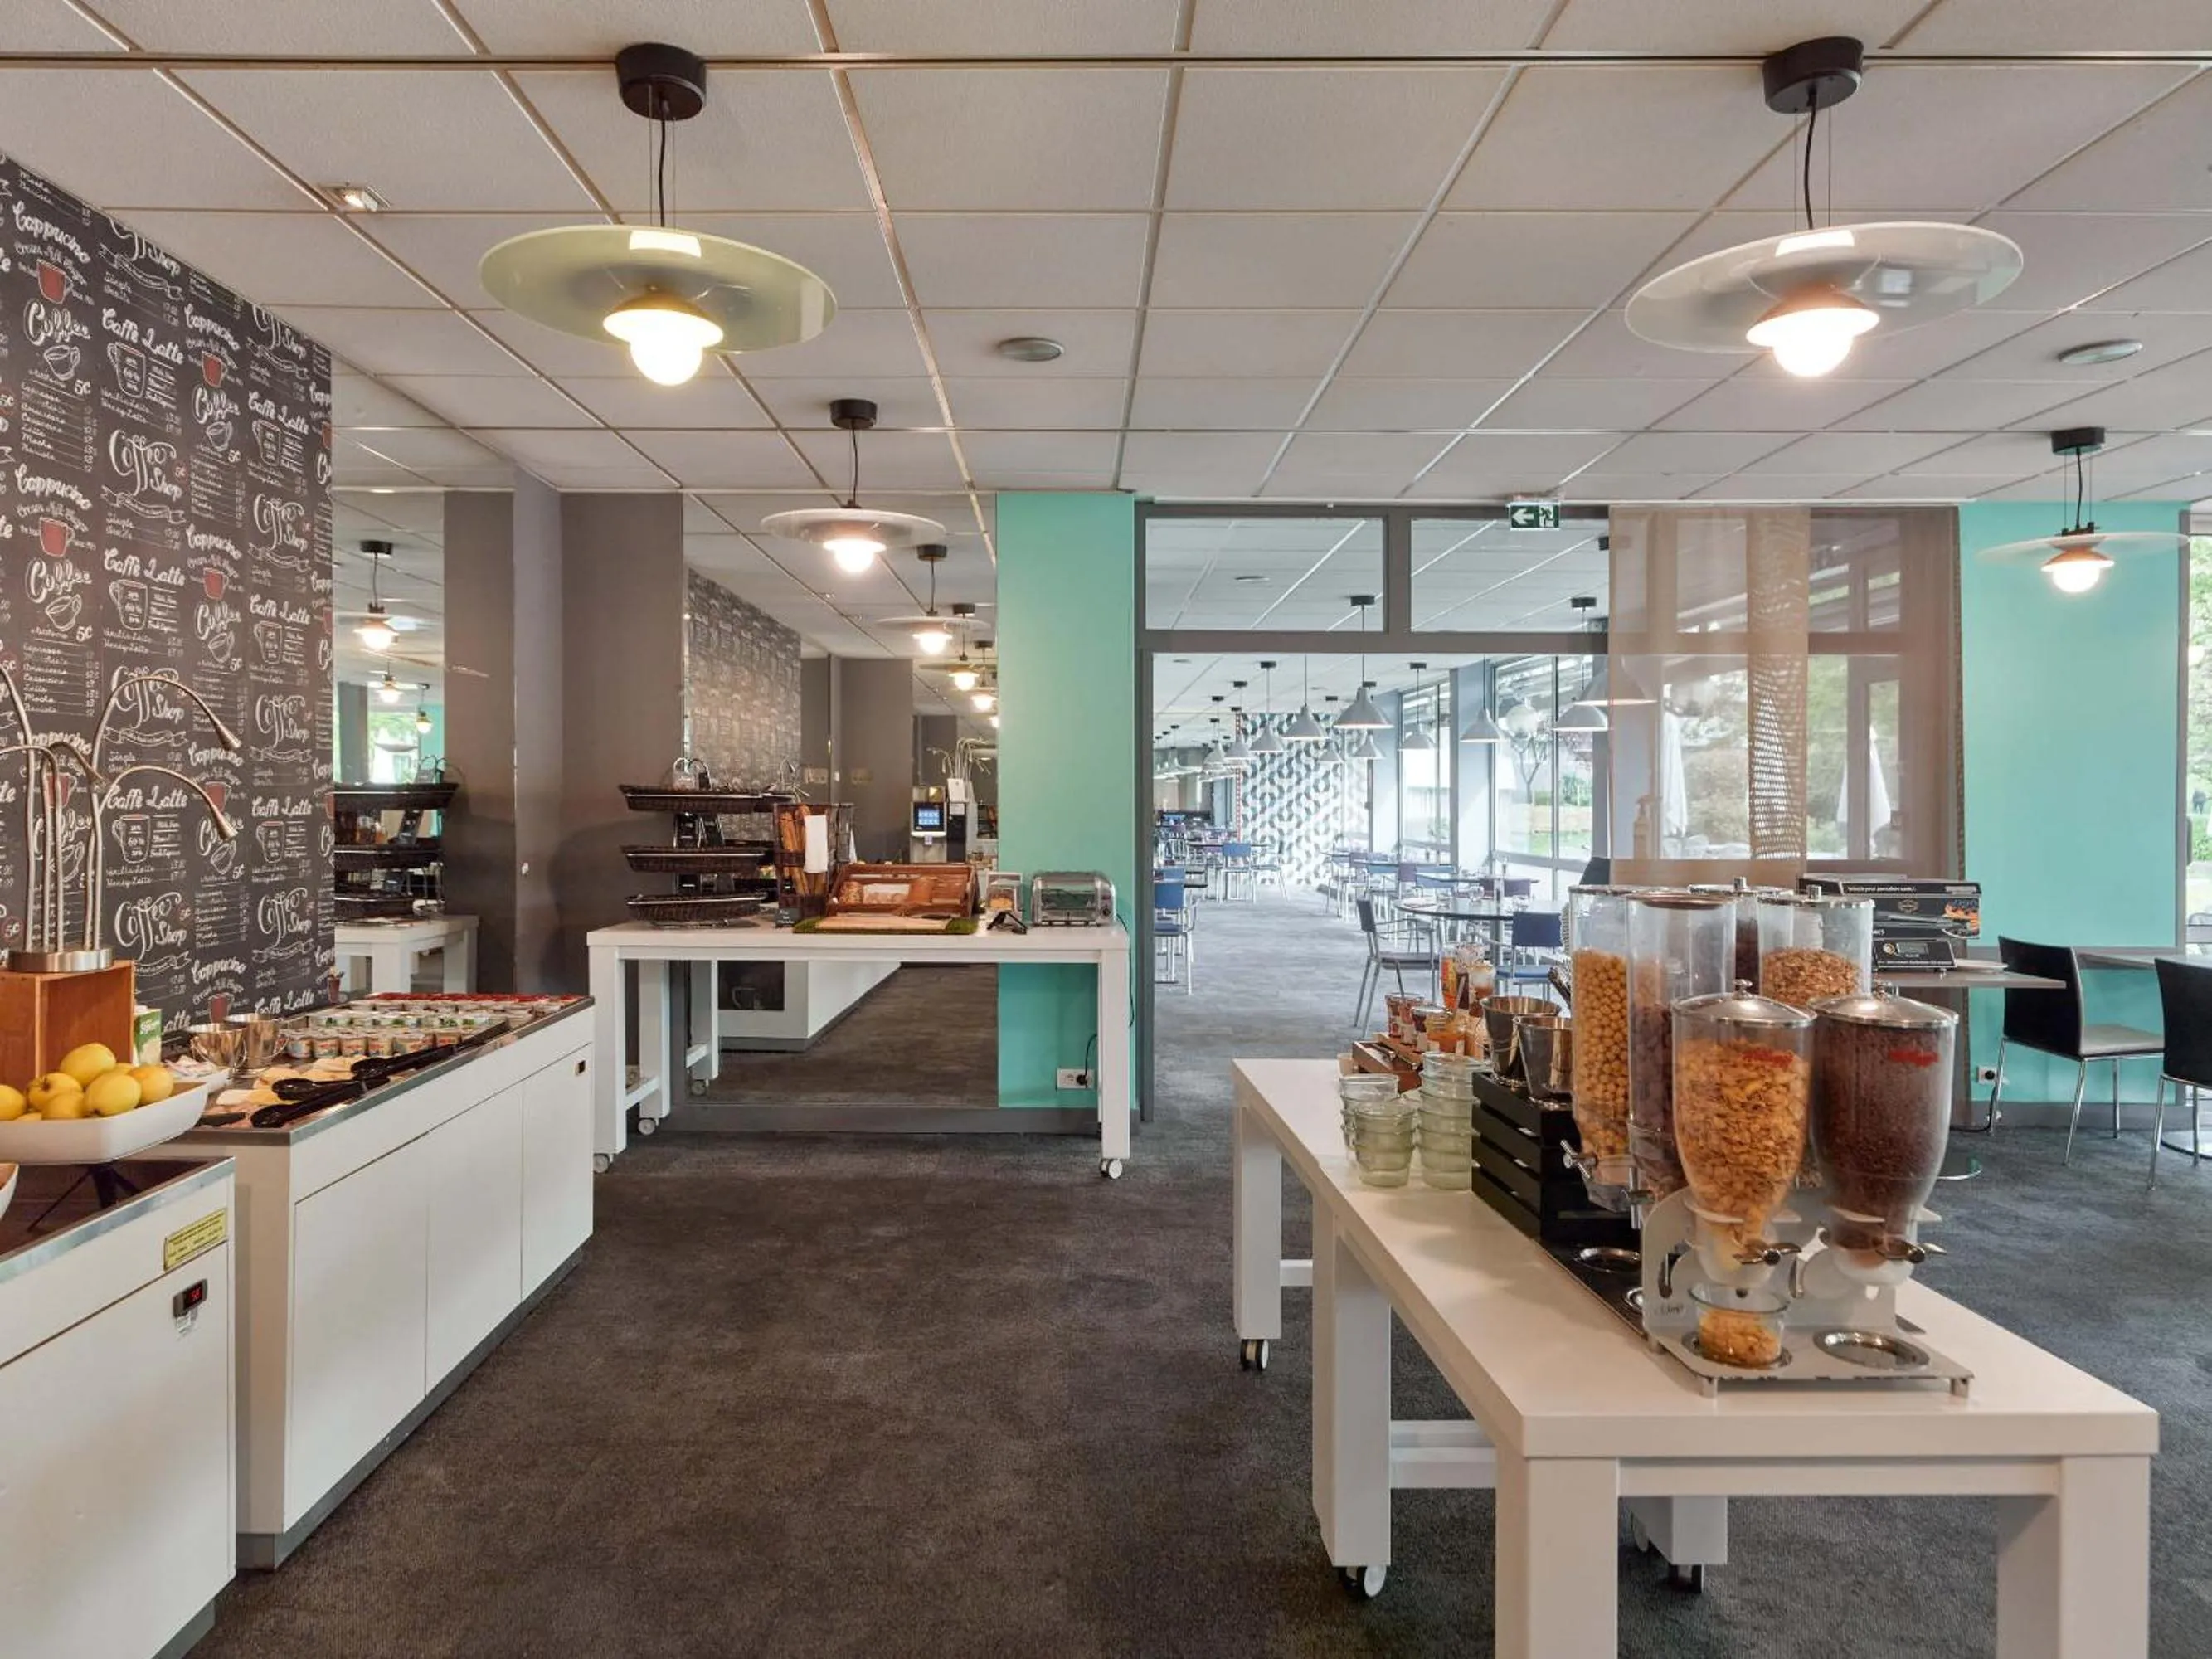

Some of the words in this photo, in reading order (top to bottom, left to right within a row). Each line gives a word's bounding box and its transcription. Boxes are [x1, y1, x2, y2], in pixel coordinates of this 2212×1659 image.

[23, 298, 91, 346] Coffee
[141, 327, 184, 366] Latte
[191, 384, 241, 425] Coffee
[277, 406, 309, 435] Latte
[109, 429, 177, 497] Coffee
[149, 467, 182, 502] Shop
[253, 493, 304, 552] Coffee
[284, 523, 308, 552] Shop
[25, 557, 93, 603] Coffee
[143, 557, 186, 586] Latte
[194, 600, 241, 640] Coffee
[279, 601, 310, 625] Latte
[152, 694, 185, 725] Shop
[255, 693, 305, 748] Coffee
[285, 717, 309, 743] Shop
[146, 785, 188, 810] Latte
[281, 796, 312, 817] Latte
[114, 892, 182, 961] Coffee
[258, 887, 308, 947] Coffee
[288, 912, 312, 934] Shop
[155, 921, 187, 947] Shop
[284, 988, 315, 1010] Latte
